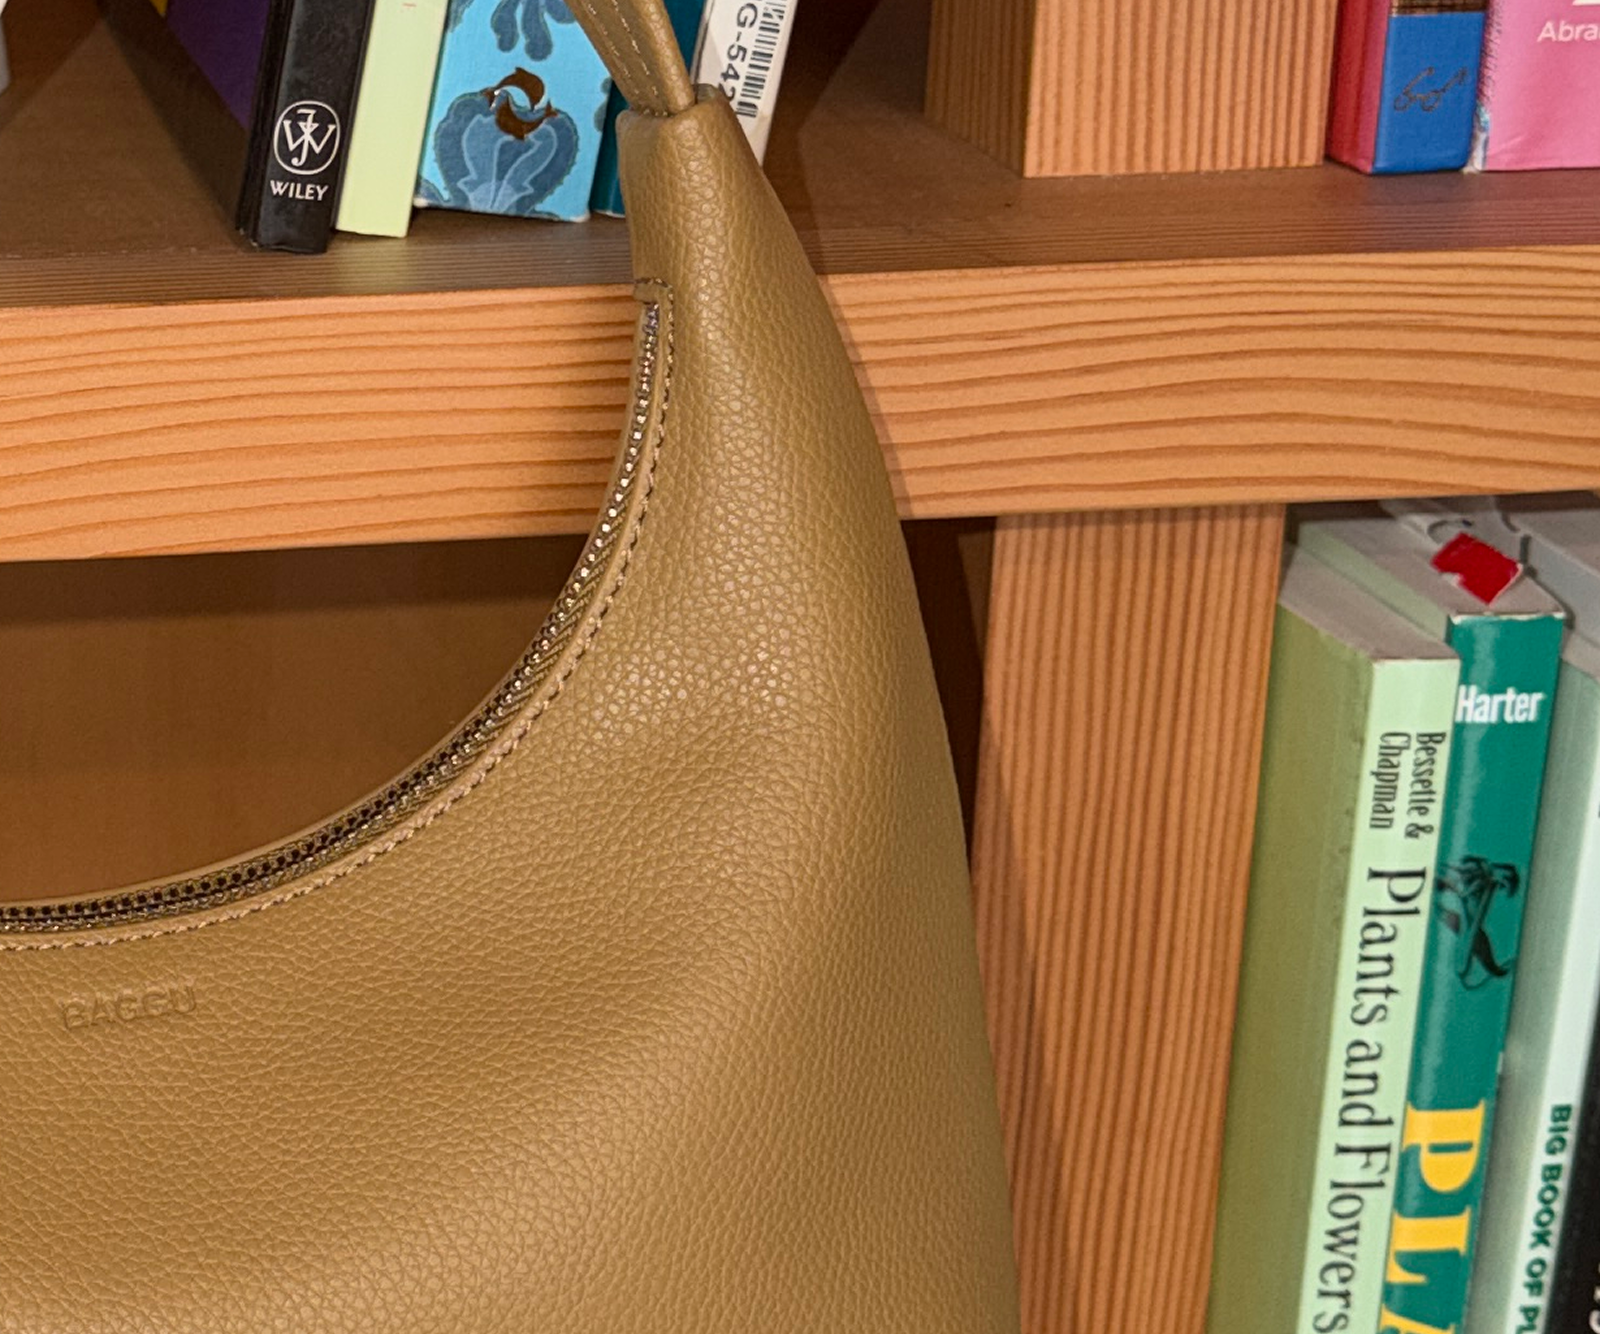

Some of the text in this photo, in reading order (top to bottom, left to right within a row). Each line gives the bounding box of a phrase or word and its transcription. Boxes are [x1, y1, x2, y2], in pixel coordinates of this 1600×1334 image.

[270, 179, 328, 201] WILEY
[1456, 685, 1546, 724] Harter
[1369, 731, 1411, 830] Chapman
[1405, 731, 1447, 819] Bessette
[1351, 867, 1427, 1026] Plants
[1337, 1040, 1394, 1131] and
[1546, 1104, 1572, 1157] BIG
[1529, 1163, 1563, 1250] BOOK
[1523, 1257, 1548, 1299] OF
